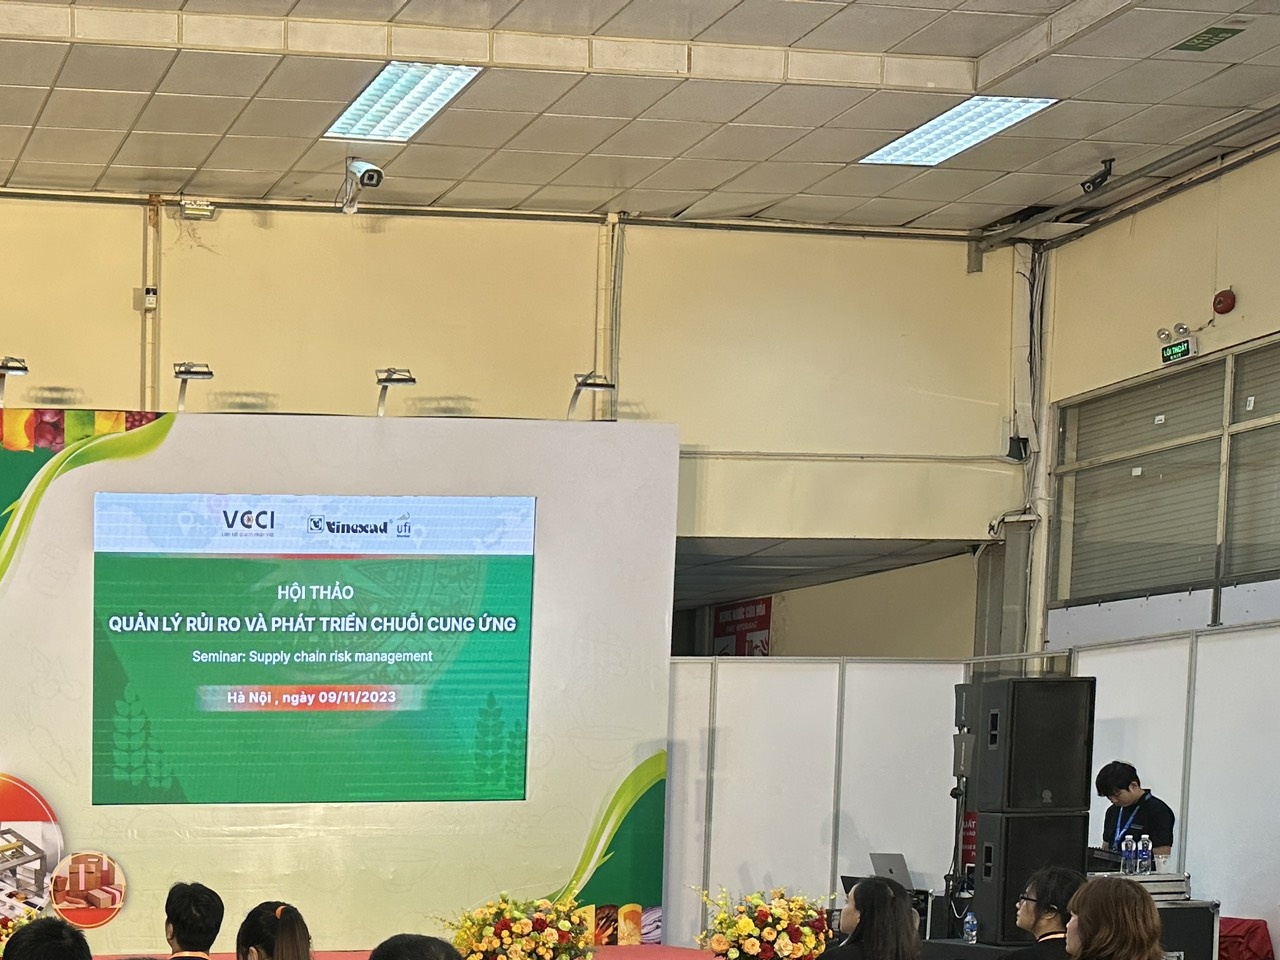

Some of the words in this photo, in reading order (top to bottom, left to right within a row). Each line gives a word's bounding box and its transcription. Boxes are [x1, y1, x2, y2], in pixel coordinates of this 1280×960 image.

[223, 510, 274, 529] VCCI
[326, 521, 387, 534] Vinexad
[396, 522, 411, 534] ufi
[278, 582, 305, 602] HỘI
[310, 581, 353, 599] THẢO
[109, 612, 159, 633] QUẢN
[163, 613, 182, 631] LÝ
[187, 613, 213, 631] RỦI
[218, 617, 240, 631] RO
[245, 613, 267, 631] VÀ
[272, 613, 315, 631] PHÁT
[320, 613, 366, 631] TRIỂN
[371, 613, 423, 631] CHUỖI
[428, 617, 475, 632] CUNG
[479, 614, 515, 631] ỨNG
[192, 650, 246, 662] Seminar:
[249, 650, 291, 665] Supply
[294, 650, 326, 662] chain
[330, 650, 351, 662] risk
[355, 651, 432, 664] management
[227, 691, 245, 704] Hà
[283, 691, 316, 707] ngày
[319, 691, 397, 704] 09/11/2023
